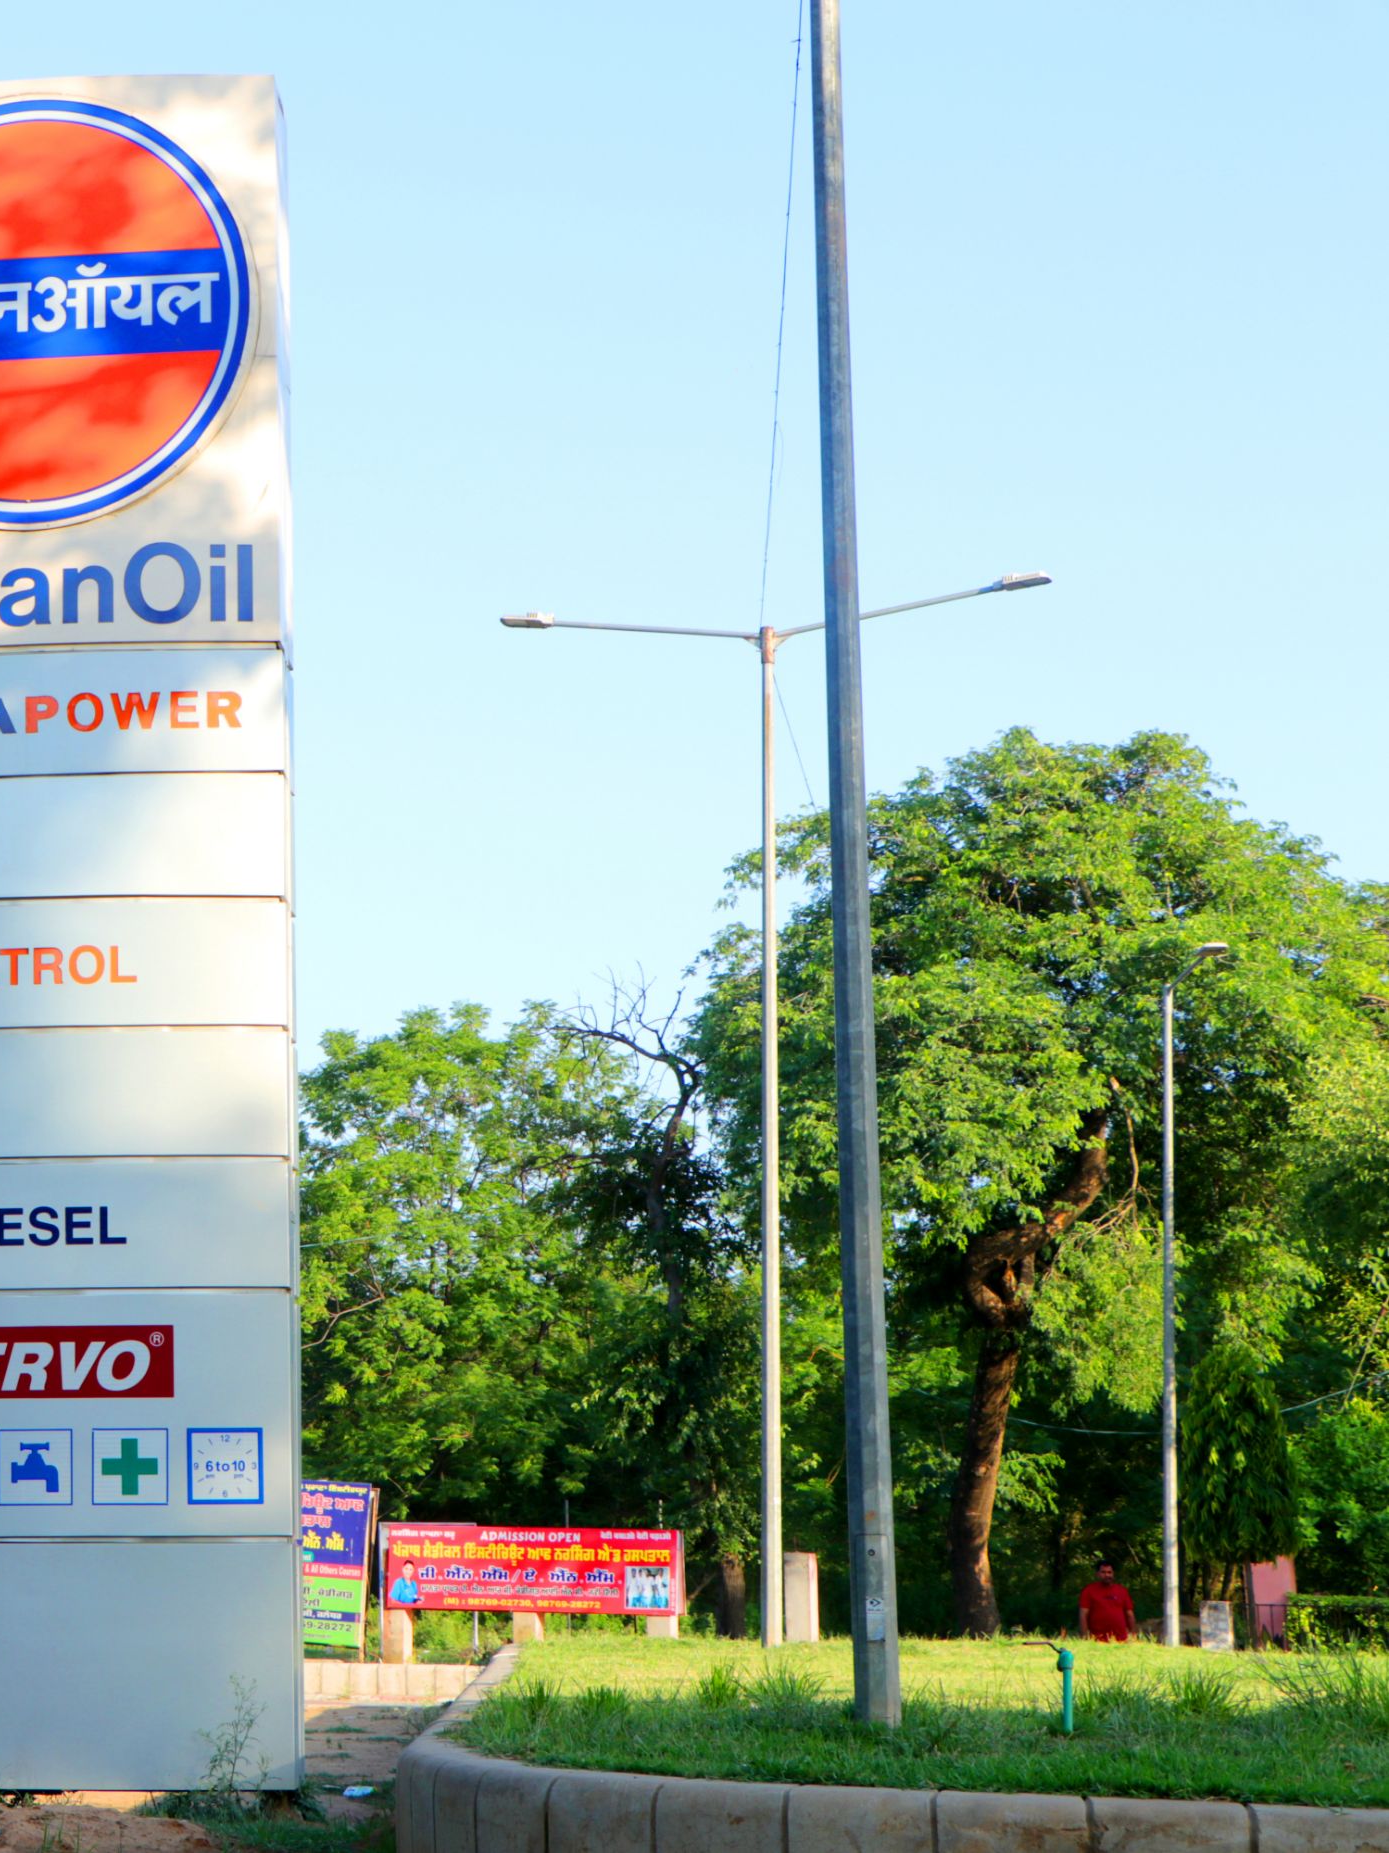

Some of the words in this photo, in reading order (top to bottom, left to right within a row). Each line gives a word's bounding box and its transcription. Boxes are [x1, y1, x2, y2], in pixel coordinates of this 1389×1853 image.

[221, 1434, 230, 1442] 12
[193, 1462, 199, 1470] 9
[205, 1460, 214, 1472] 6
[216, 1461, 230, 1472] to
[232, 1460, 245, 1472] 10
[251, 1462, 257, 1470] 3
[222, 1490, 228, 1498] 6
[480, 1531, 545, 1541] ADMISSION
[548, 1532, 581, 1542] OPEN
[393, 1541, 420, 1558] ਪੰਜਾਬ
